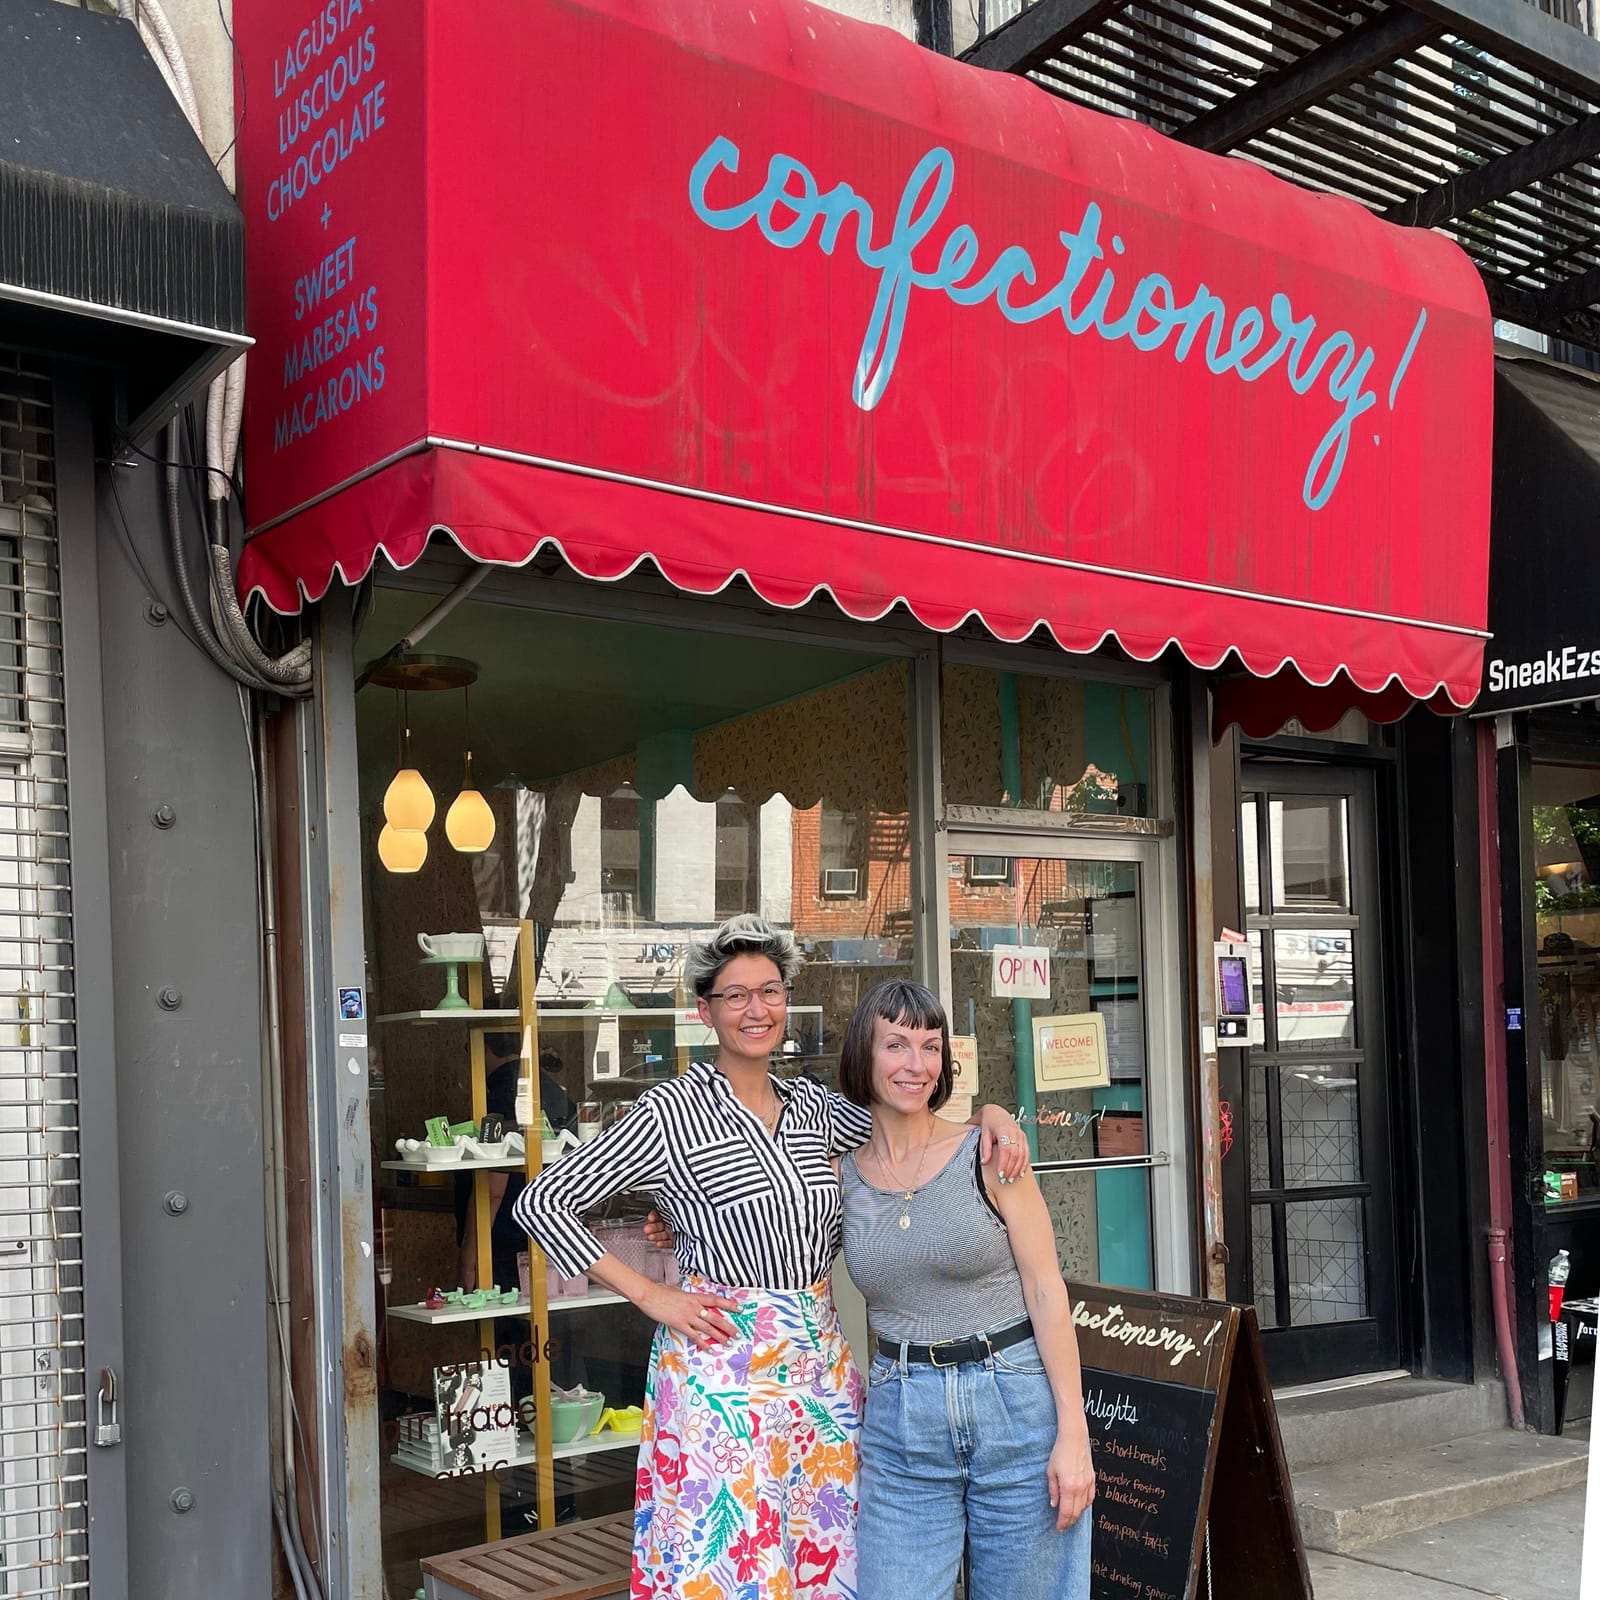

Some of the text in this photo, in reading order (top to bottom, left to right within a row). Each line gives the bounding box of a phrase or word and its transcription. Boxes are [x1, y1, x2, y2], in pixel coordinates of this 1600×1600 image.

[273, 0, 376, 97] LAGUSTA
[277, 24, 377, 155] LUSCIOUS
[266, 79, 386, 223] CHOCOLATE
[294, 235, 358, 322] SWEET
[690, 136, 1426, 511] confectionery!
[282, 284, 379, 390] MARESA'S
[273, 344, 387, 454] MACARONS
[998, 956, 1048, 986] OPEN
[1045, 1035, 1093, 1051] WELCOME!
[1084, 1389, 1139, 1430] hlights
[1133, 1479, 1167, 1499] frosting
[1142, 1531, 1169, 1555] tarts
